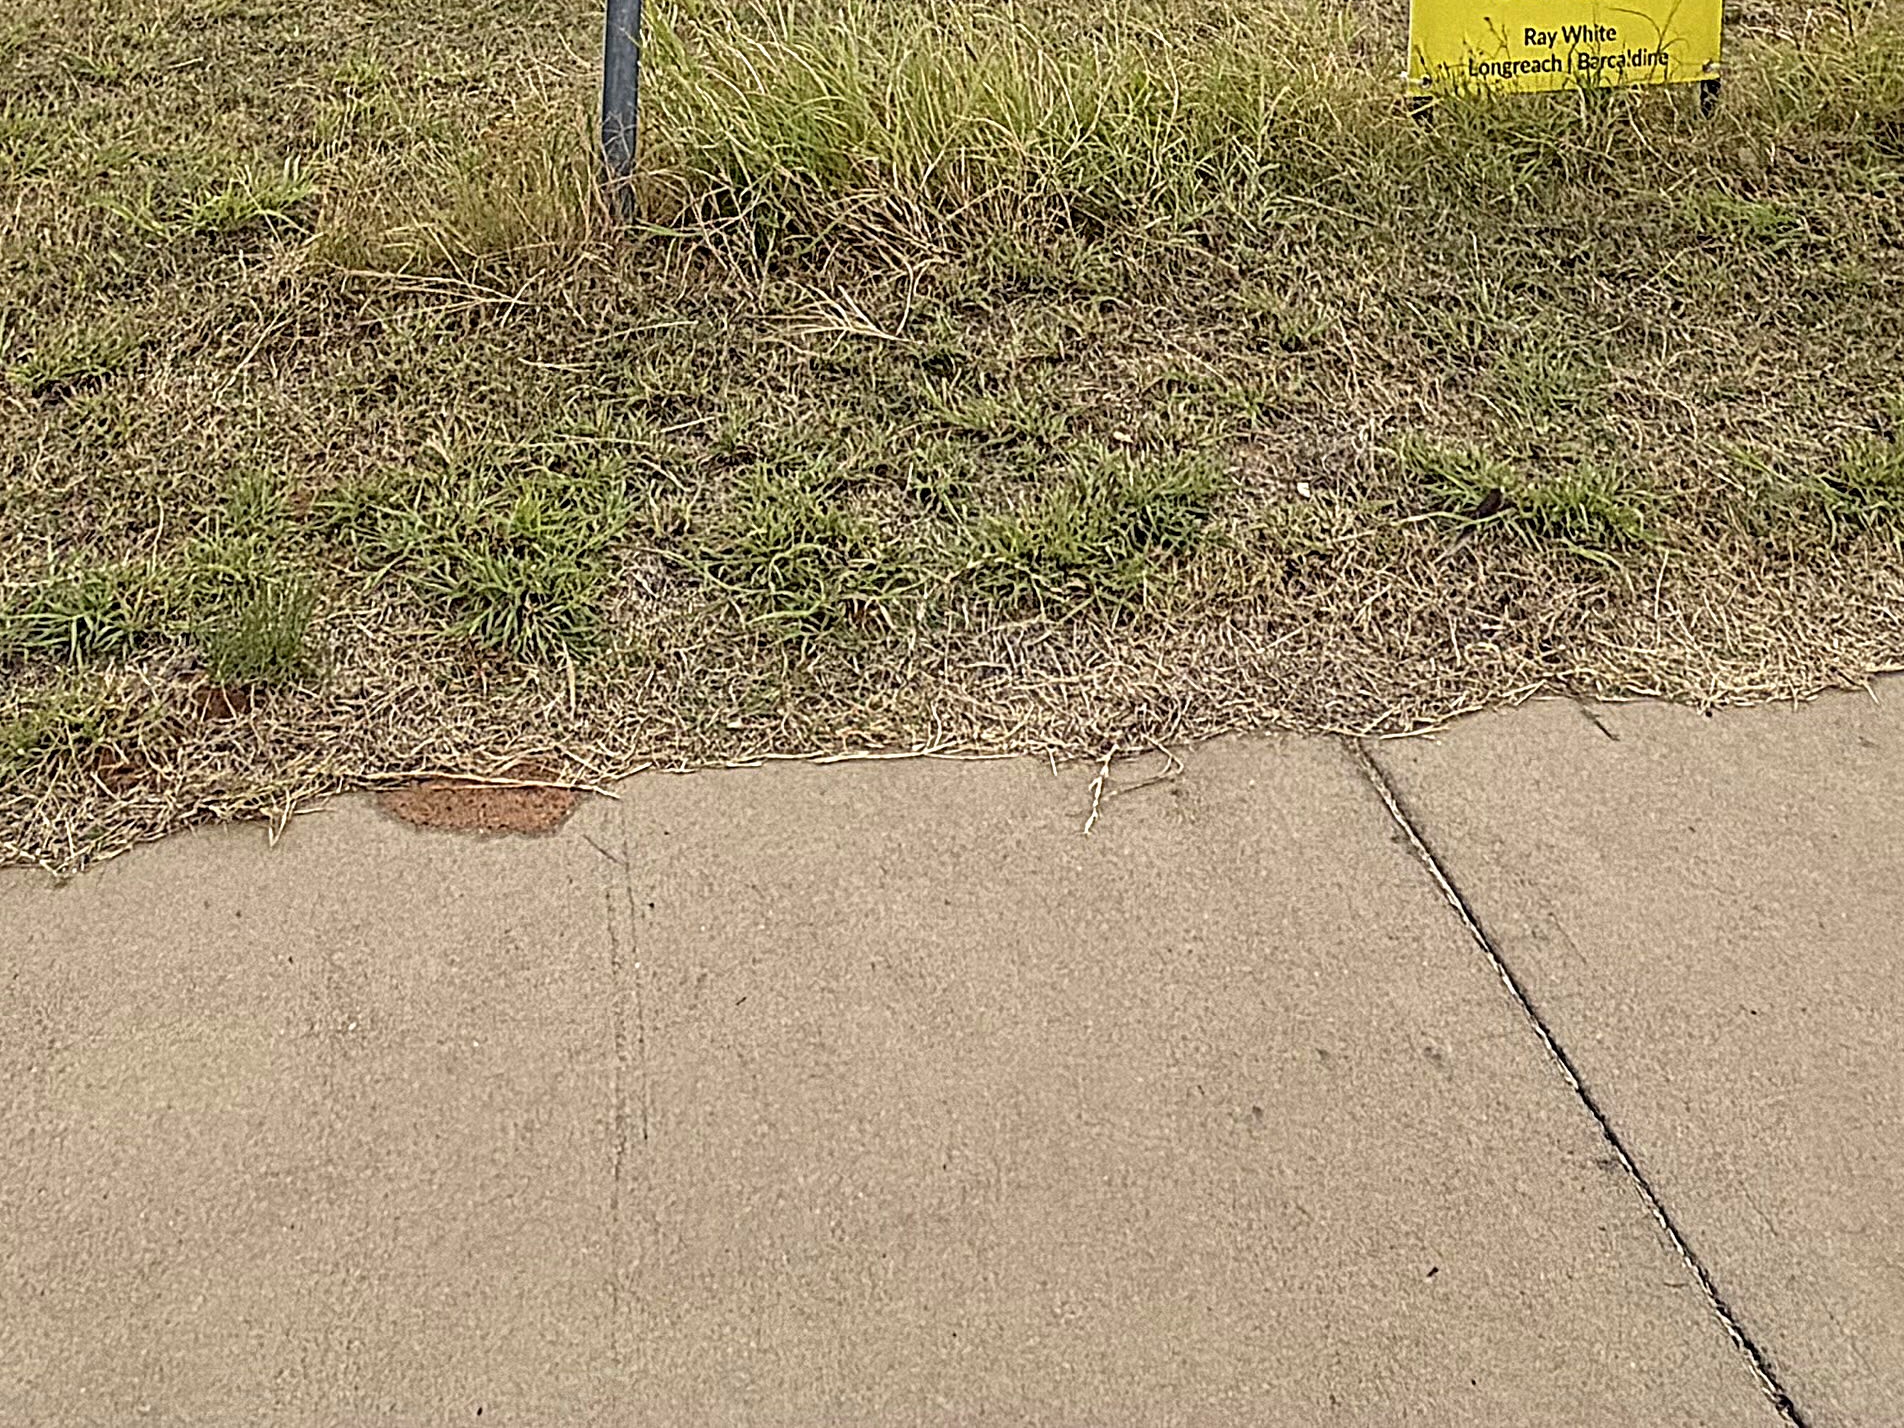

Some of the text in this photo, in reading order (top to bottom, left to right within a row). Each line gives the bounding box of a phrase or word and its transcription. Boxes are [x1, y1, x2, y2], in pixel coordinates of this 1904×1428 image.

[1524, 25, 1617, 48] Ray White
[1468, 54, 1563, 78] Longreach
